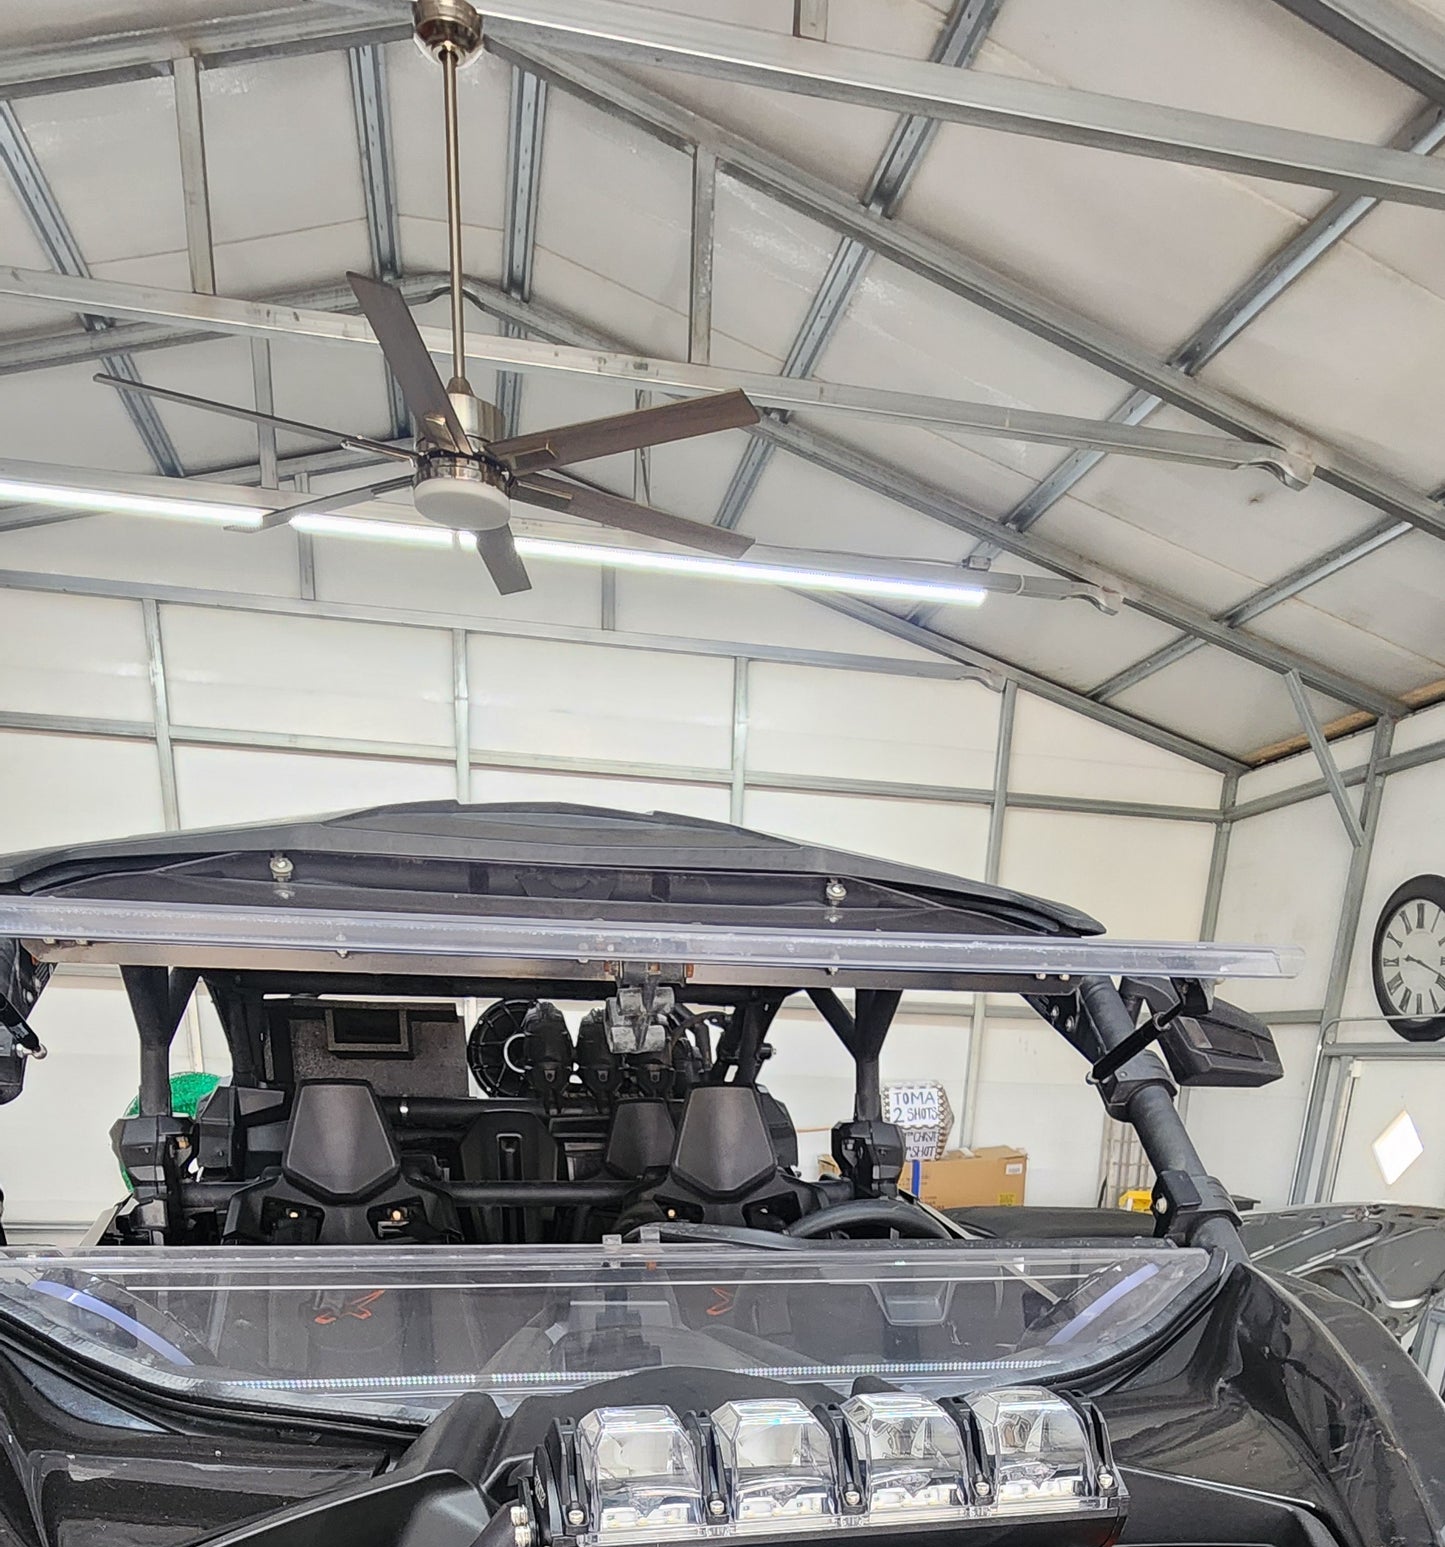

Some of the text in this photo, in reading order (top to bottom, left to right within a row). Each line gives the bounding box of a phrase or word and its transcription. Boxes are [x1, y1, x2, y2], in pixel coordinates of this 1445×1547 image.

[894, 1091, 935, 1105] TOMA
[893, 1107, 938, 1124] 2 SHOTS
